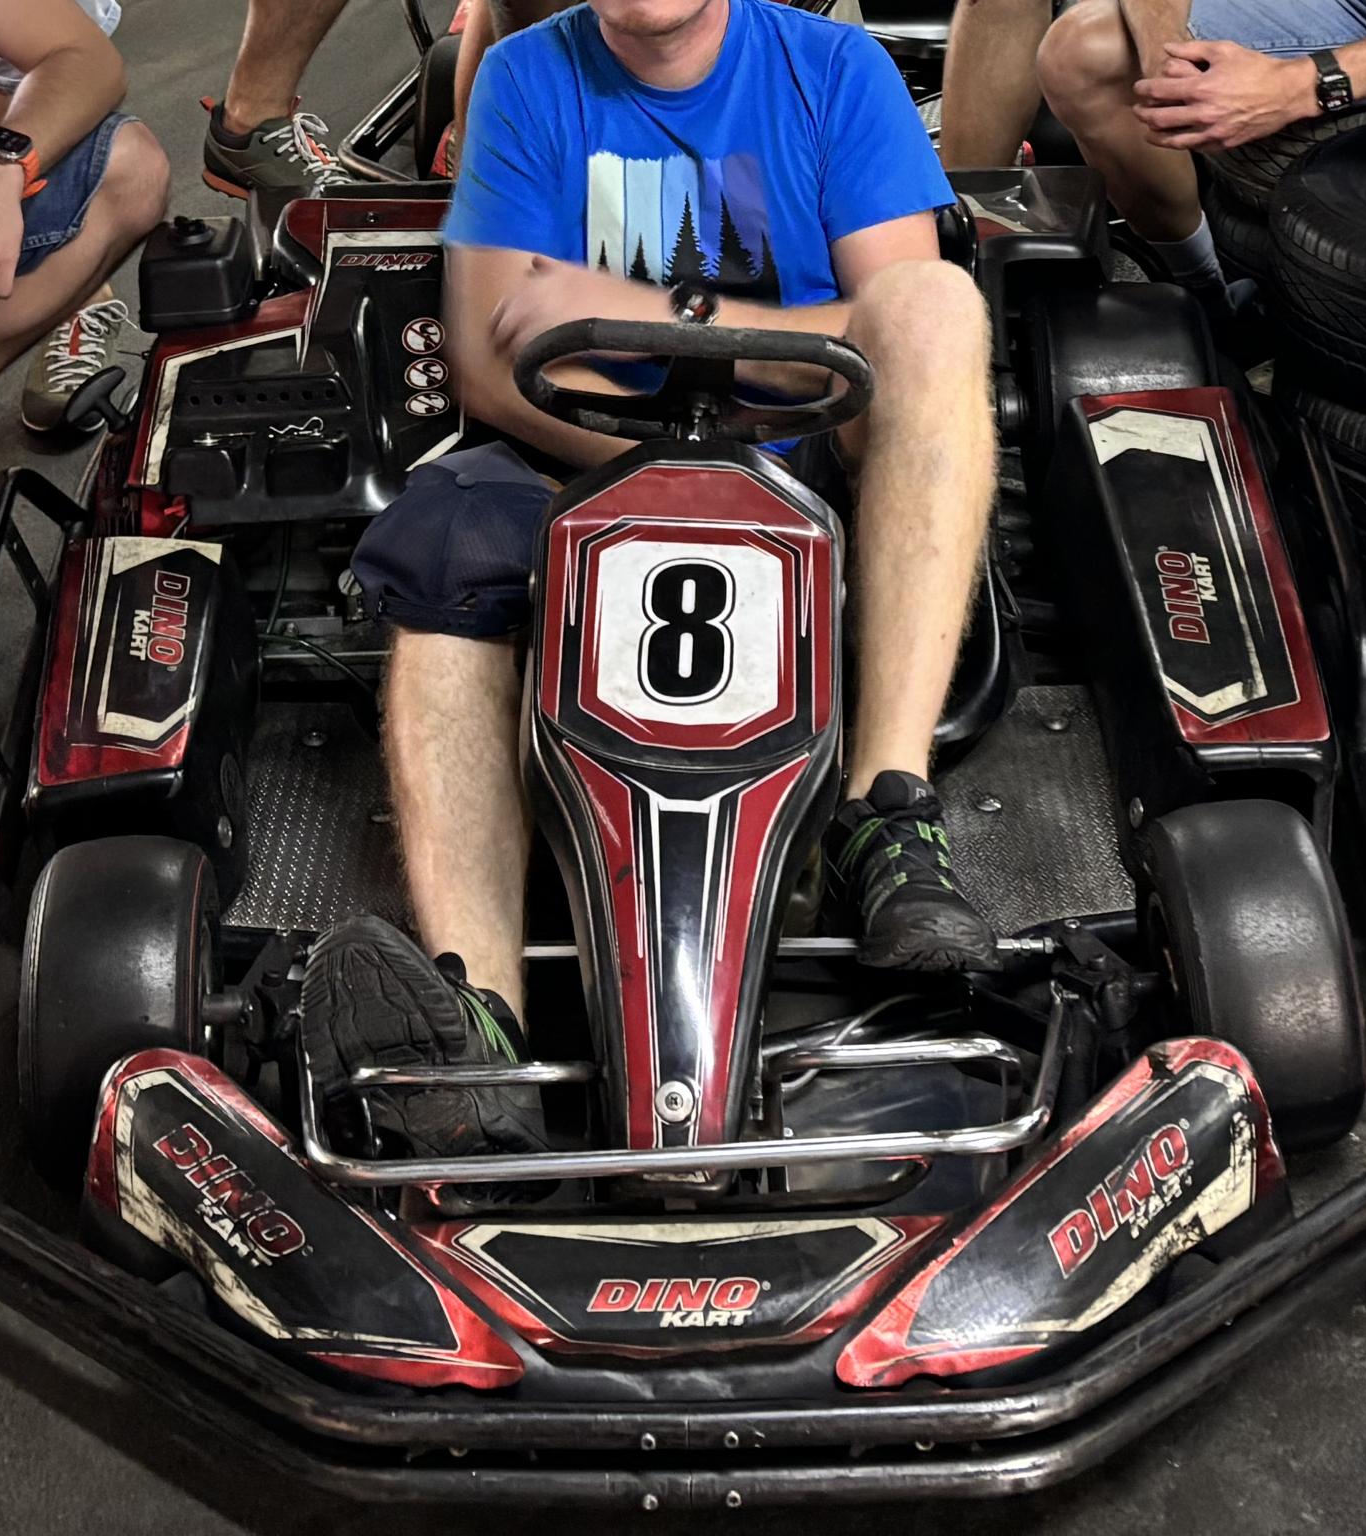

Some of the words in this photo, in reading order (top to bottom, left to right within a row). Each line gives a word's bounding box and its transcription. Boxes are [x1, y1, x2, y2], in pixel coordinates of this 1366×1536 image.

[337, 252, 434, 267] DINO
[375, 263, 425, 272] KART
[1156, 550, 1212, 645] DINO
[1190, 552, 1218, 602] KART
[129, 609, 150, 661] KART
[146, 570, 191, 668] DINO
[637, 557, 736, 707] 8
[152, 1122, 308, 1258] DINO
[1046, 1122, 1190, 1280] DINO
[586, 1277, 762, 1314] DINO
[658, 1309, 753, 1328] KART
